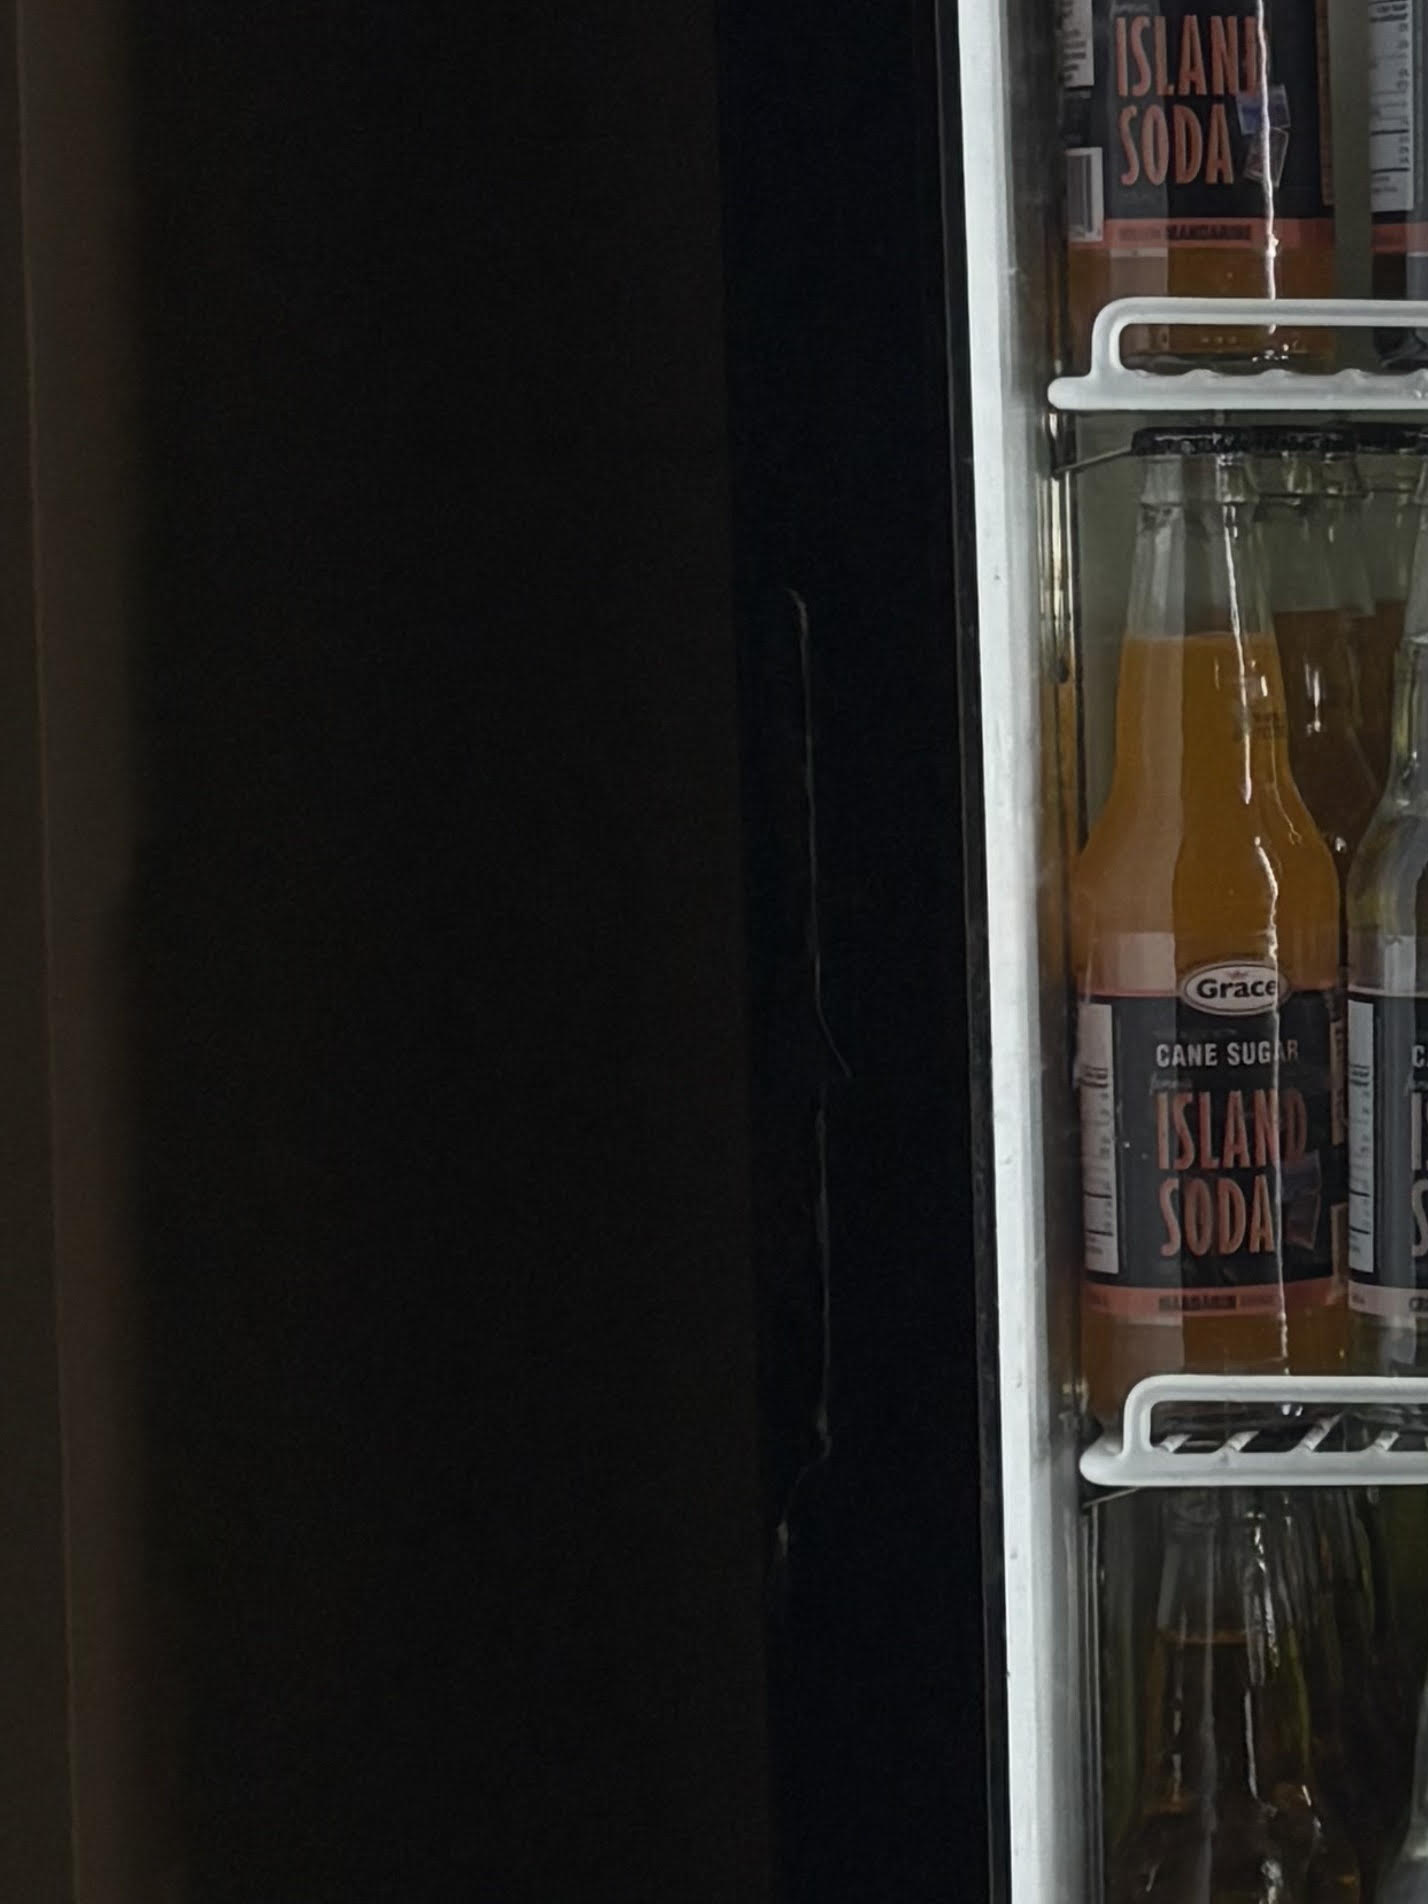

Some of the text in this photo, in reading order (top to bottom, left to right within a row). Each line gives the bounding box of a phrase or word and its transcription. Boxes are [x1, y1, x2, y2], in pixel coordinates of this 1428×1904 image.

[1119, 103, 1236, 186] SODA
[1196, 977, 1278, 1000] Grace
[1155, 1038, 1300, 1067] CANE SUGAR
[1153, 1088, 1309, 1171] ISLAND
[1158, 1173, 1277, 1257] SODA
